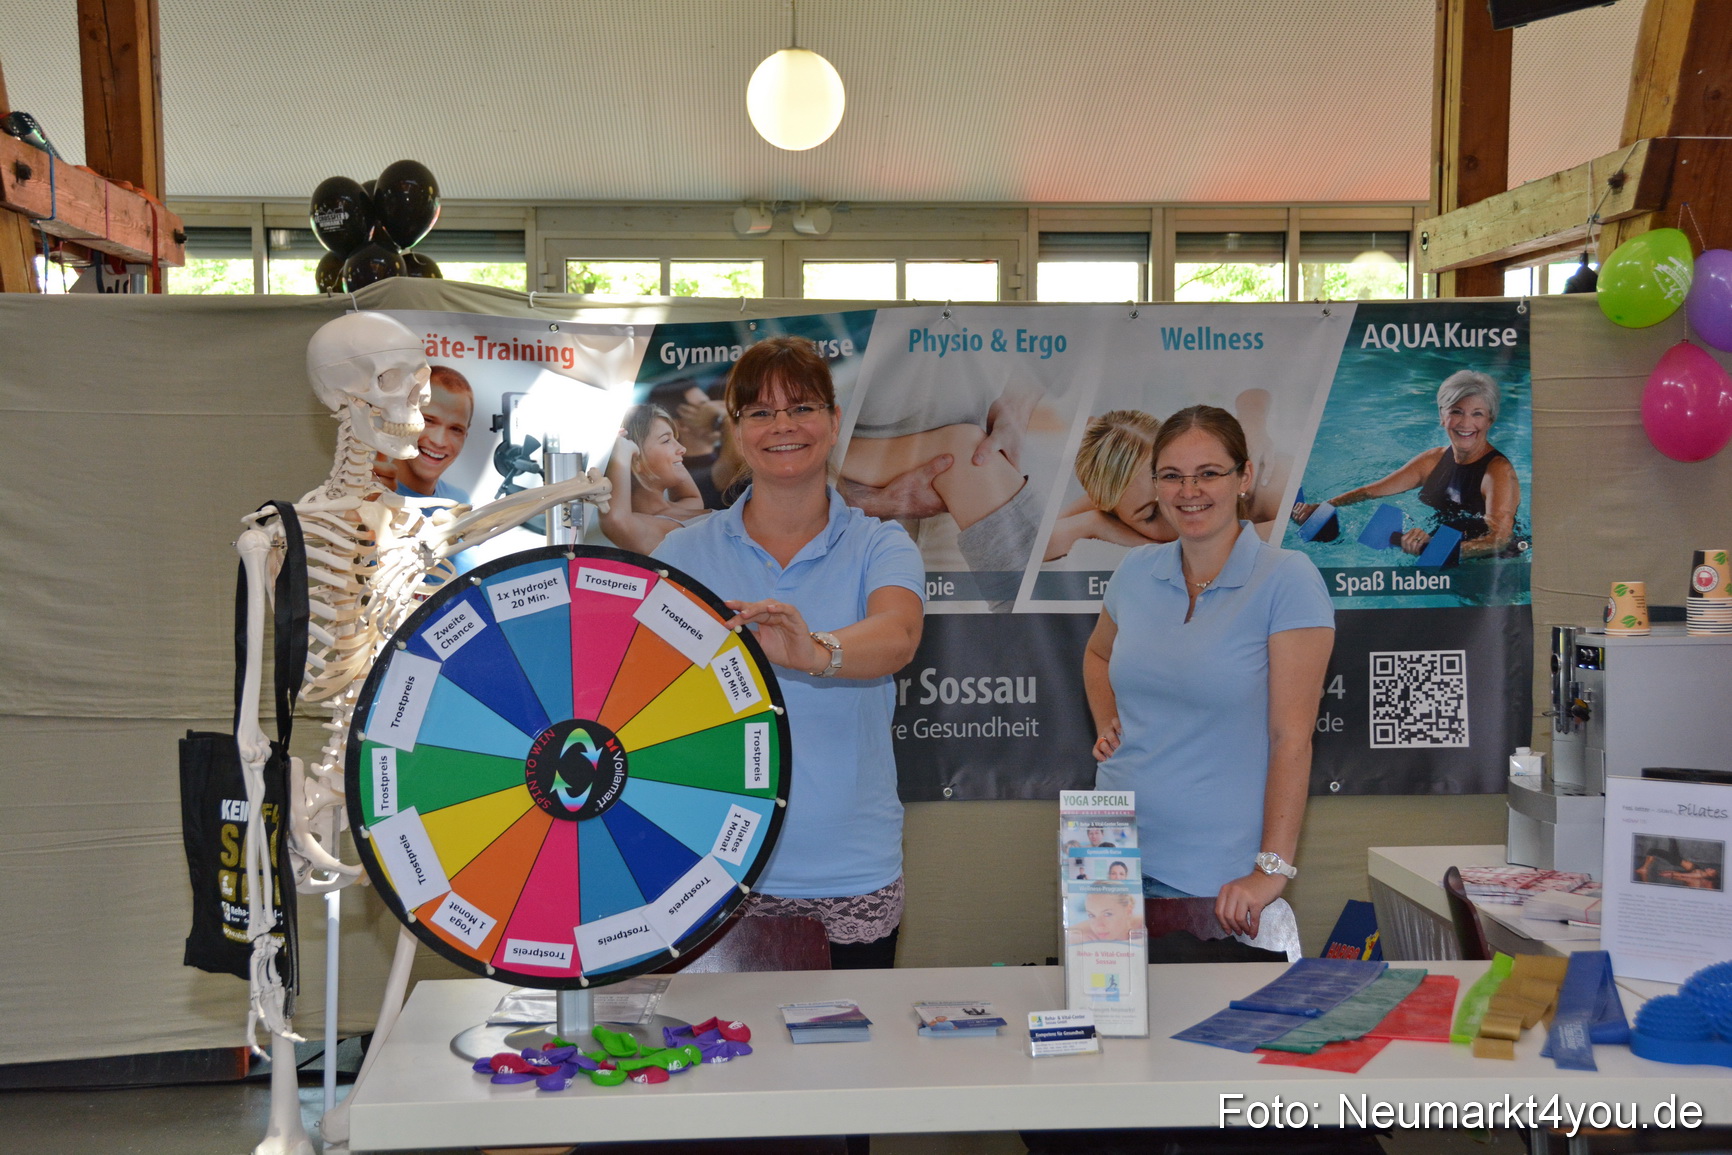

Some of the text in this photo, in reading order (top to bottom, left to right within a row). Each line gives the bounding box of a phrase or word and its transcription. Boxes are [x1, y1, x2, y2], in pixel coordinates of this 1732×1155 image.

[908, 329, 1067, 359] Physio & Ergo
[1161, 327, 1264, 351] Wellness
[497, 577, 558, 602] 1x Hydrojet
[584, 574, 638, 592] Trostpreis
[1336, 571, 1450, 593] Spaß haben
[511, 593, 549, 610] 20 Min.
[433, 613, 466, 641] Zweite
[441, 619, 475, 651] Chance
[660, 604, 704, 641] Trostpreis
[720, 666, 740, 701] 20 Min.
[729, 656, 752, 698] Massage
[920, 668, 1036, 705] Sossau
[391, 674, 415, 729] Trostpreis
[913, 716, 1039, 738] Gesundheit
[527, 729, 555, 809] SPIN TO WIN
[753, 729, 761, 782] Trostpreis
[380, 755, 390, 811] Trostpreis
[597, 751, 624, 808] Voilamart
[1063, 796, 1129, 806] YOGA SPECIAL
[1677, 804, 1728, 818] Pilates
[719, 820, 738, 852] Monat
[730, 820, 750, 854] Pilates
[400, 834, 427, 885] Trostpreis
[668, 876, 711, 915] Trostpreis
[448, 901, 478, 926] Monat
[449, 915, 471, 935] Yoga
[598, 924, 650, 945] Trostpreis
[512, 946, 566, 960] Trostpreis
